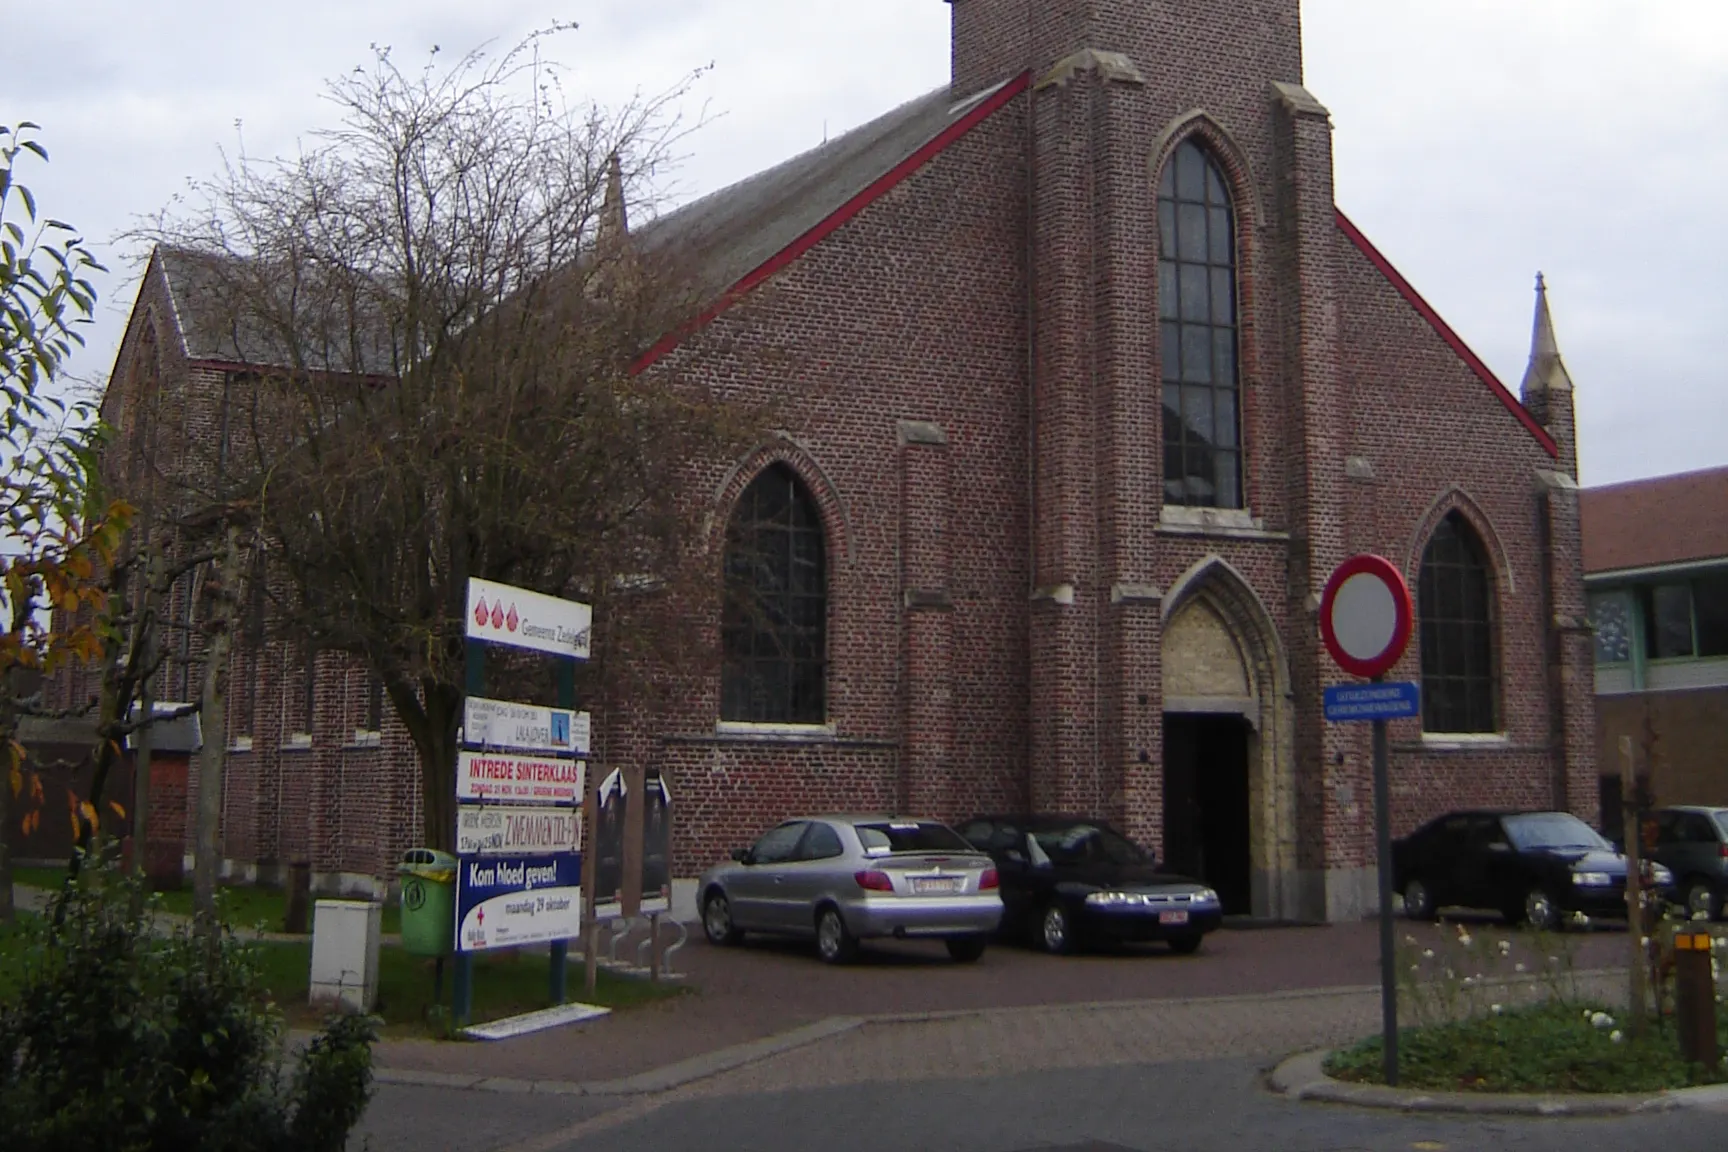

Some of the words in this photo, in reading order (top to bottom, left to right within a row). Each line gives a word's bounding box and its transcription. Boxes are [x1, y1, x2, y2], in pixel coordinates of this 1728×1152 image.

[470, 759, 513, 780] INTREDE
[516, 762, 577, 784] SINTERKLAAS
[505, 815, 552, 845] ZWEMMEN
[470, 862, 495, 887] Kom
[497, 861, 524, 885] bloed
[525, 860, 557, 890] geven!
[506, 899, 535, 917] maandag
[546, 897, 571, 911] oktober
